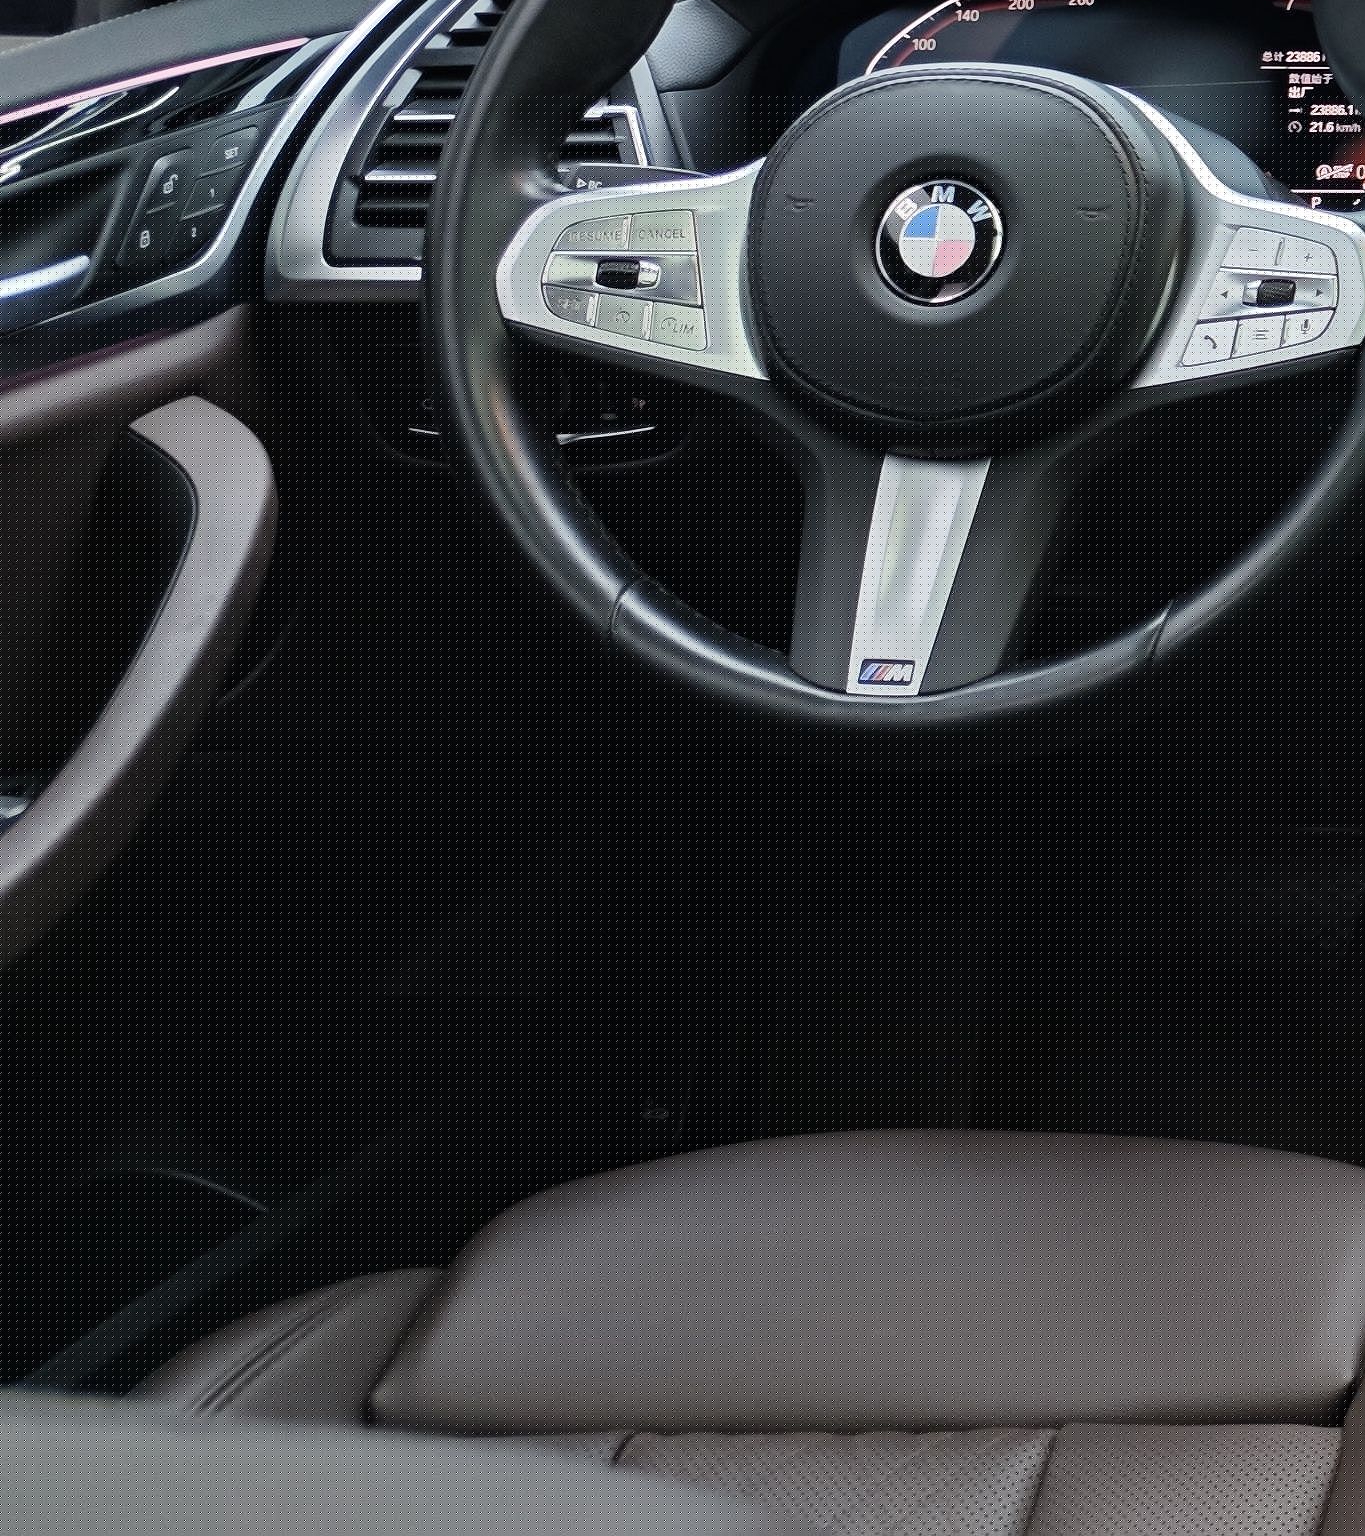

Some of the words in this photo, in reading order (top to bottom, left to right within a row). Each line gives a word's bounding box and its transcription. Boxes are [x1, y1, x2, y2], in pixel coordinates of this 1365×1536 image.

[955, 9, 980, 22] 140
[912, 38, 937, 52] 100
[1262, 51, 1284, 63] 总计
[1285, 51, 1321, 63] 23886
[1289, 73, 1333, 85] 数值始于
[1288, 86, 1314, 99] 出厂
[1309, 122, 1334, 133] 21.6
[894, 185, 993, 223] BMW
[566, 228, 622, 241] RESUME
[638, 228, 687, 241] CANCEL
